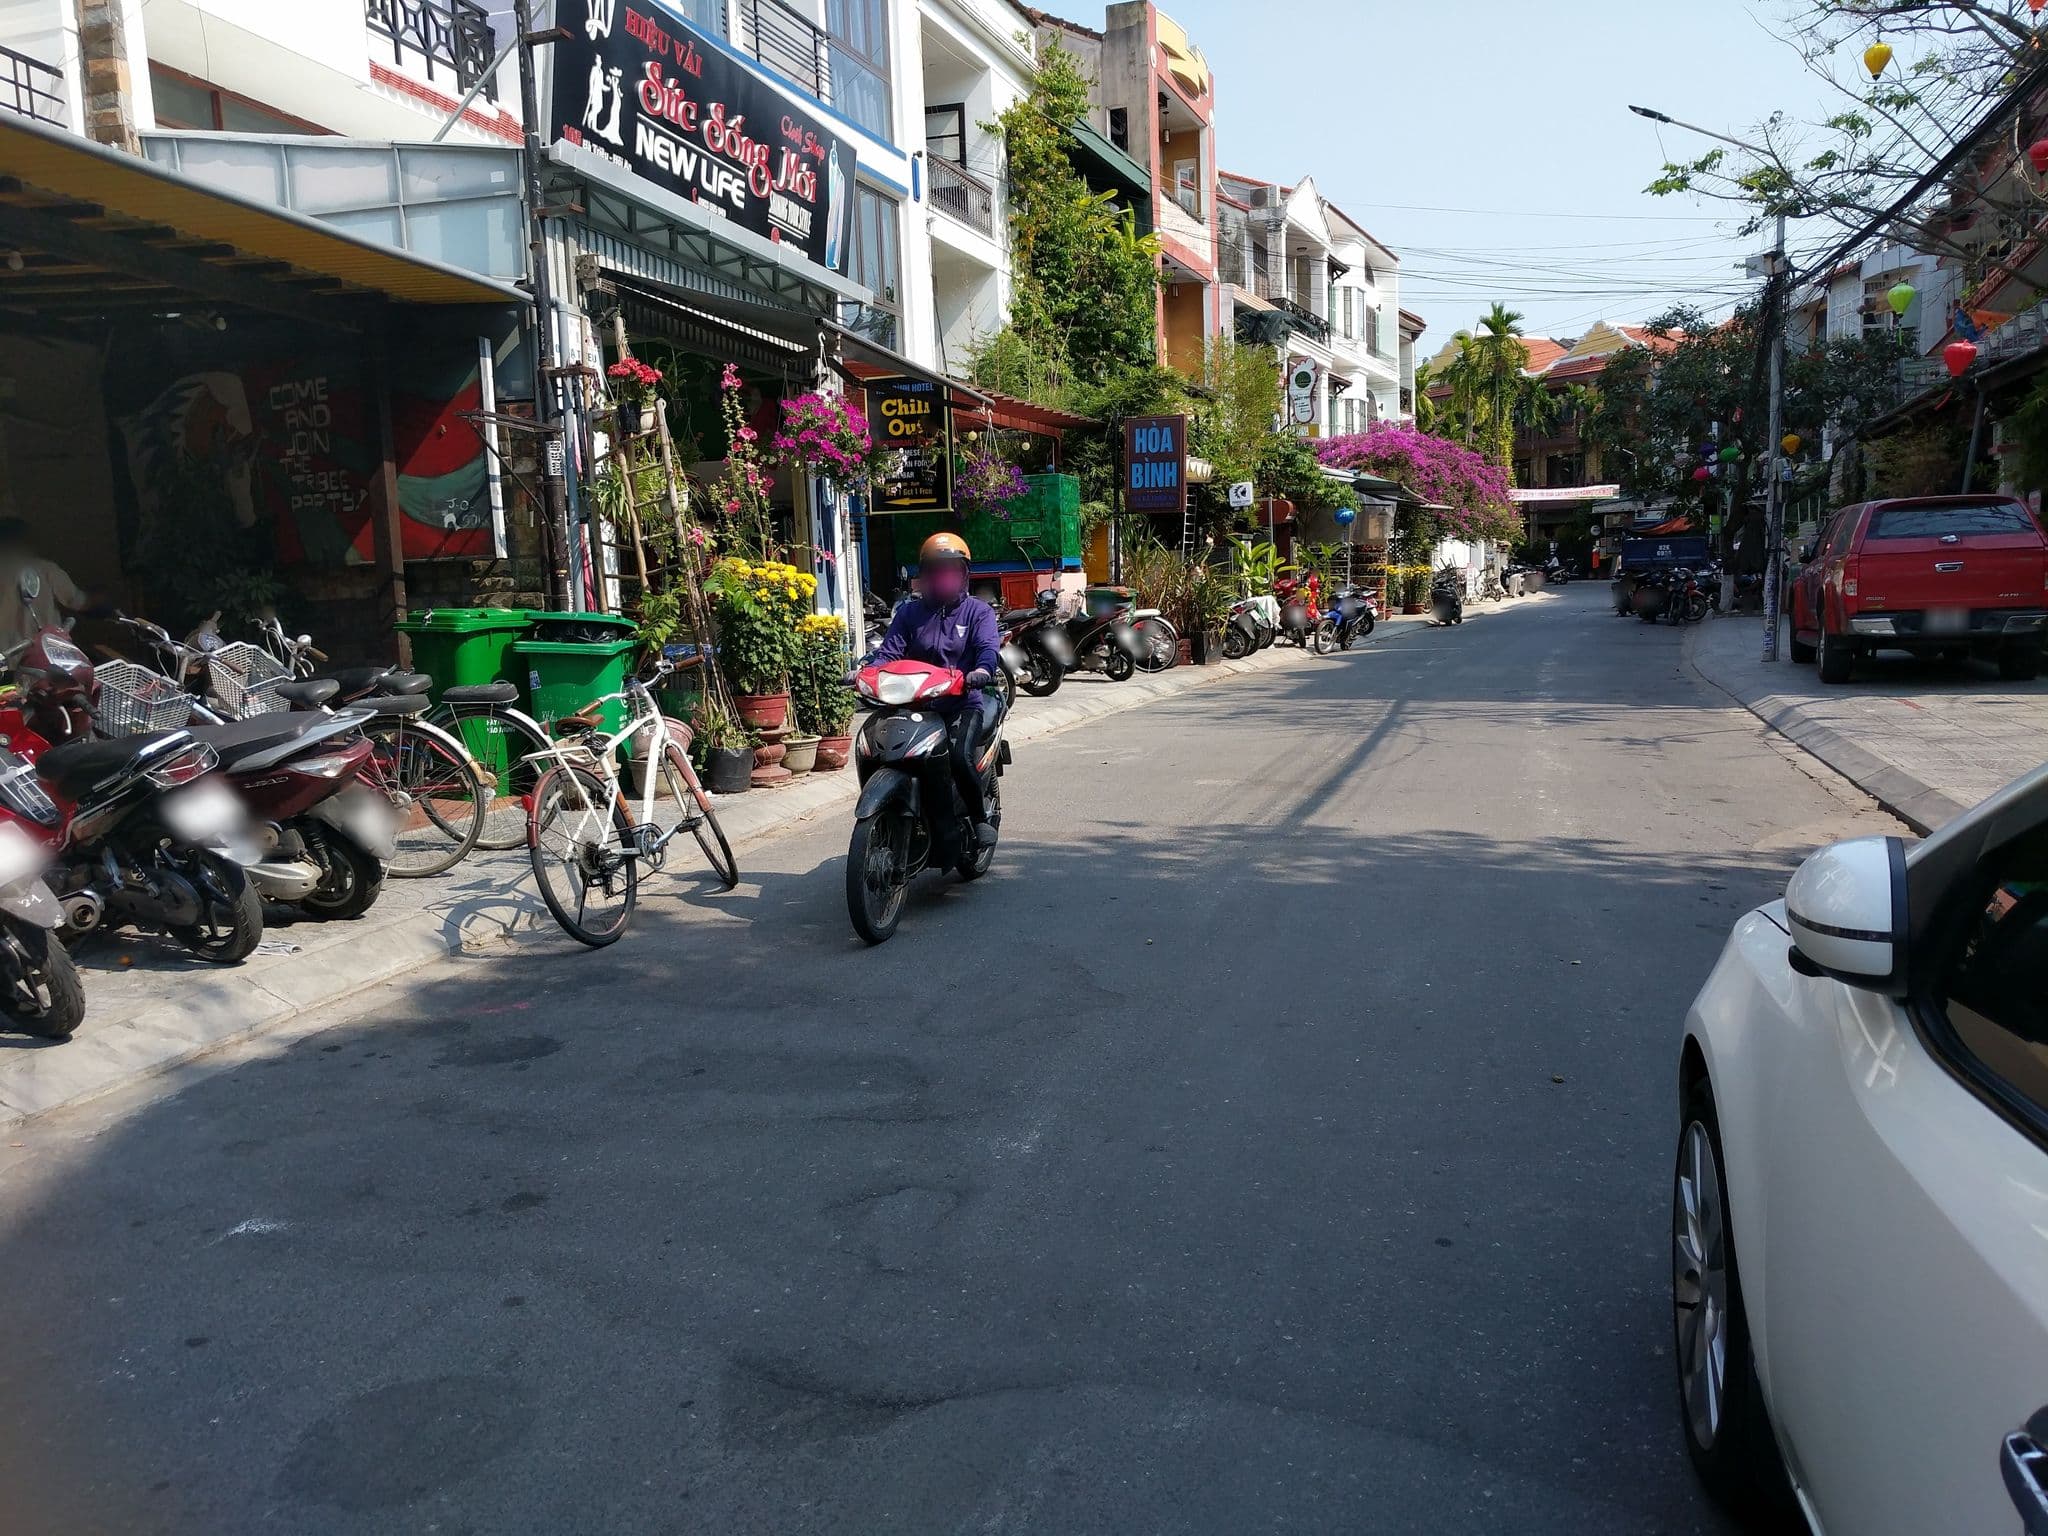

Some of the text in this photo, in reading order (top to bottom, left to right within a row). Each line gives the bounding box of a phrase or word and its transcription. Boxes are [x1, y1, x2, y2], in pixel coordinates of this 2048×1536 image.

[634, 61, 817, 203] Sức Sống Mới
[635, 122, 746, 209] NEW LIFE
[270, 377, 328, 410] COME
[911, 382, 934, 393] HOTEL
[285, 403, 331, 430] AND
[286, 431, 330, 456] JOIN
[1135, 421, 1174, 454] HÒA
[280, 455, 312, 475] THE
[1131, 456, 1178, 489] BÌNH
